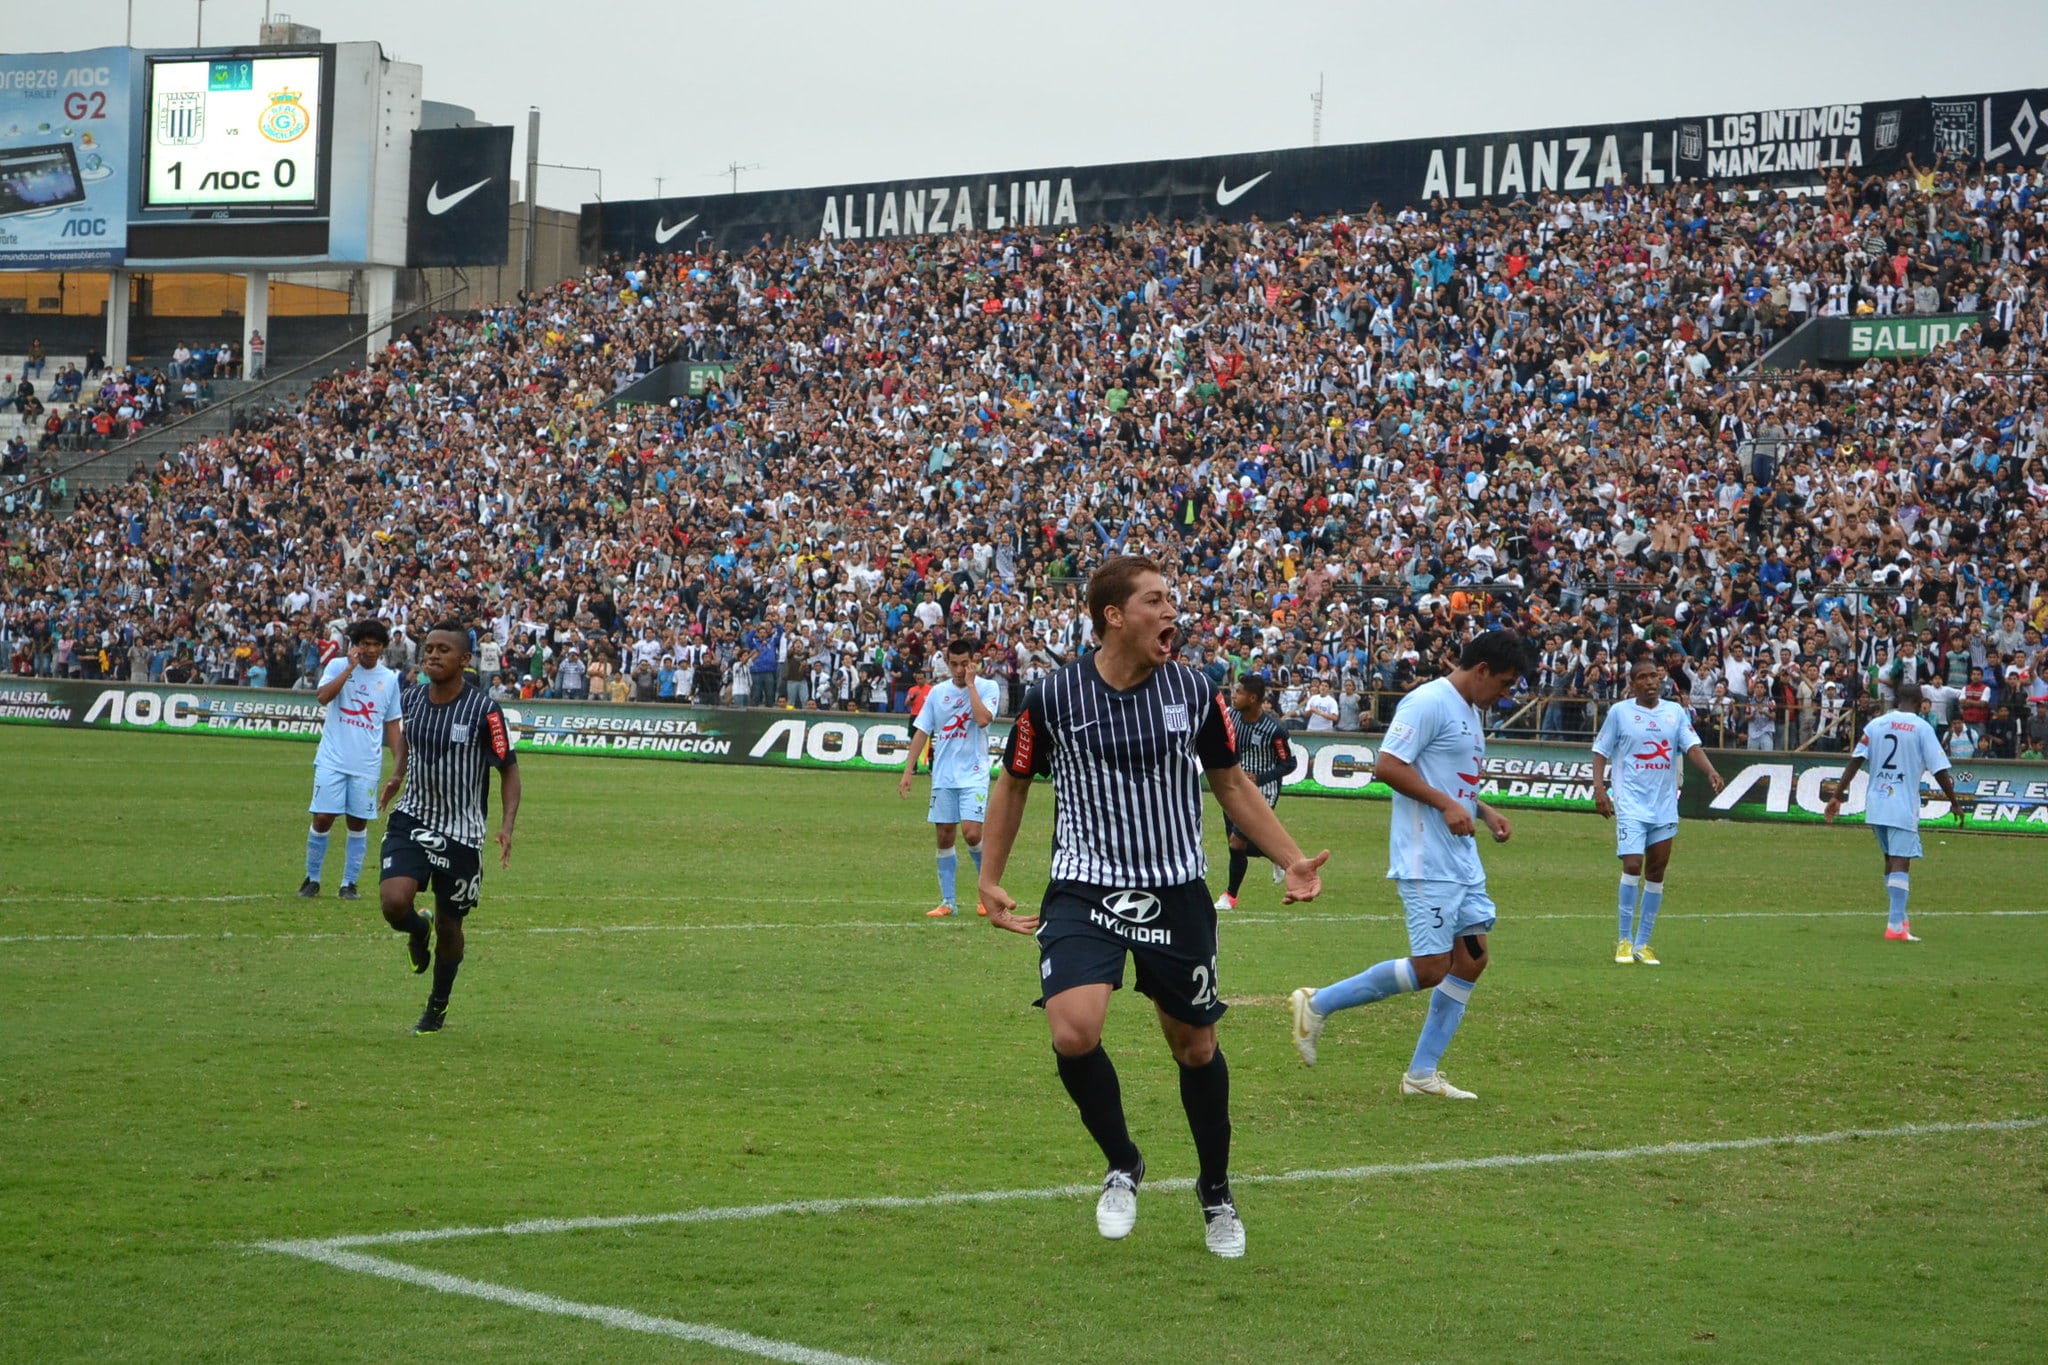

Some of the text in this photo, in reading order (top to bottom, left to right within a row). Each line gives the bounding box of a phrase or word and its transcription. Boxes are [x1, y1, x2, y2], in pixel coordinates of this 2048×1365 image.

[62, 67, 110, 88] AOC
[24, 90, 57, 99] TABLET
[64, 90, 107, 120] G2
[1707, 105, 1863, 148] LOS INTIMOS
[1422, 135, 1623, 200] ALIANZA
[1707, 138, 1863, 178] MANZANILLA
[167, 158, 296, 191] 1 AOC 0
[820, 178, 1078, 240] ALIANZA LIMA
[61, 219, 107, 237] AOC
[0, 690, 49, 705] ALISTA
[83, 690, 200, 728] AOC
[209, 700, 329, 719] EL ESPECIALIS
[207, 716, 324, 736] EN ALTA DEFIN
[533, 715, 698, 735] EL ESPECIALISTA
[532, 732, 732, 756] EN ALTA DEFINICIÓN
[749, 719, 911, 765] AOC
[1882, 734, 1898, 770] 2
[1508, 780, 1595, 801] DEFIN
[1974, 780, 2016, 797] EL
[1972, 803, 2021, 822] EN
[1090, 908, 1172, 945] HYUNDAI
[1430, 906, 1444, 929] 3
